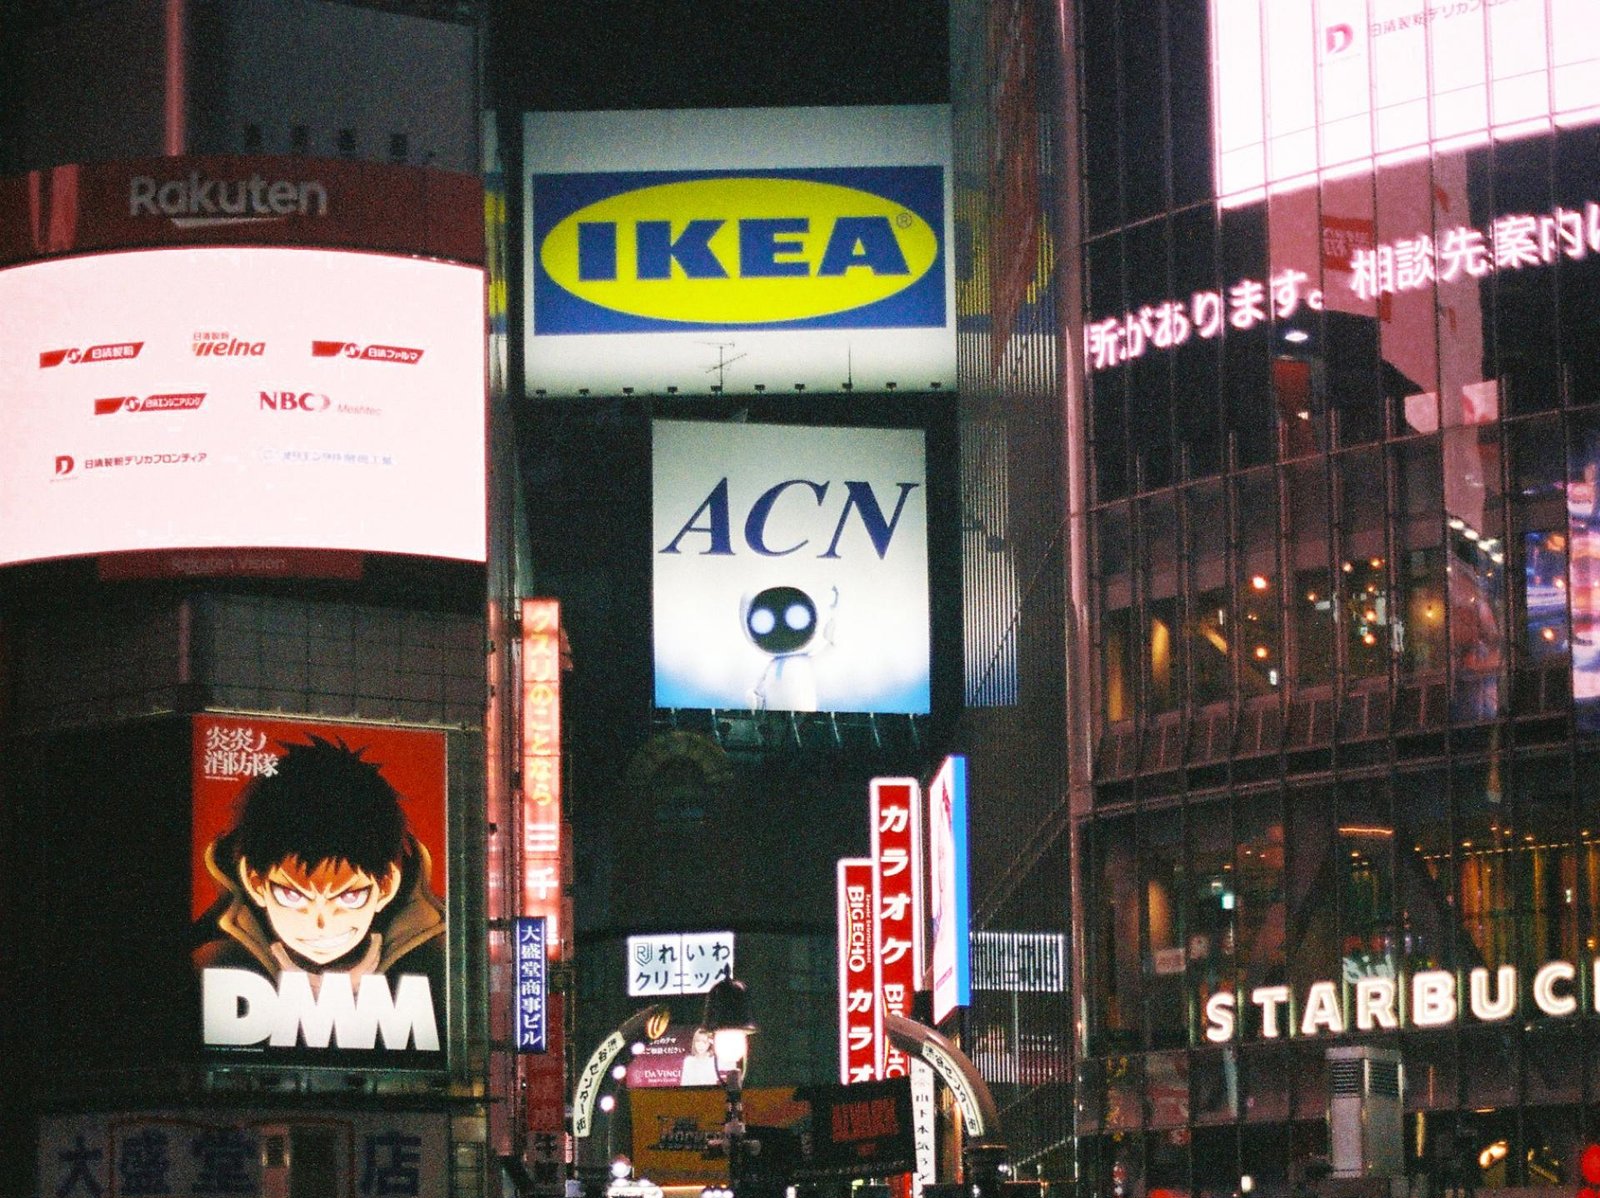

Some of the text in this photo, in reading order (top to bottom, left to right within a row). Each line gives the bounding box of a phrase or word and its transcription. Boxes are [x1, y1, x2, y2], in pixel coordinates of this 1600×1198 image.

[129, 173, 327, 216] Rakuten
[578, 216, 911, 281] IKEA
[1350, 203, 1600, 300] 相談先案内
[260, 391, 315, 411] NBC
[658, 477, 919, 559] ACN
[879, 805, 912, 965] カラオケ
[658, 942, 730, 964] れいわ
[847, 886, 867, 972] BIG ECHO
[203, 967, 440, 1051] DMM
[520, 925, 542, 1045] 大盛堂商事ビル
[1205, 959, 1600, 1043] STARBUC
[58, 1130, 422, 1198] 大盛堂店
